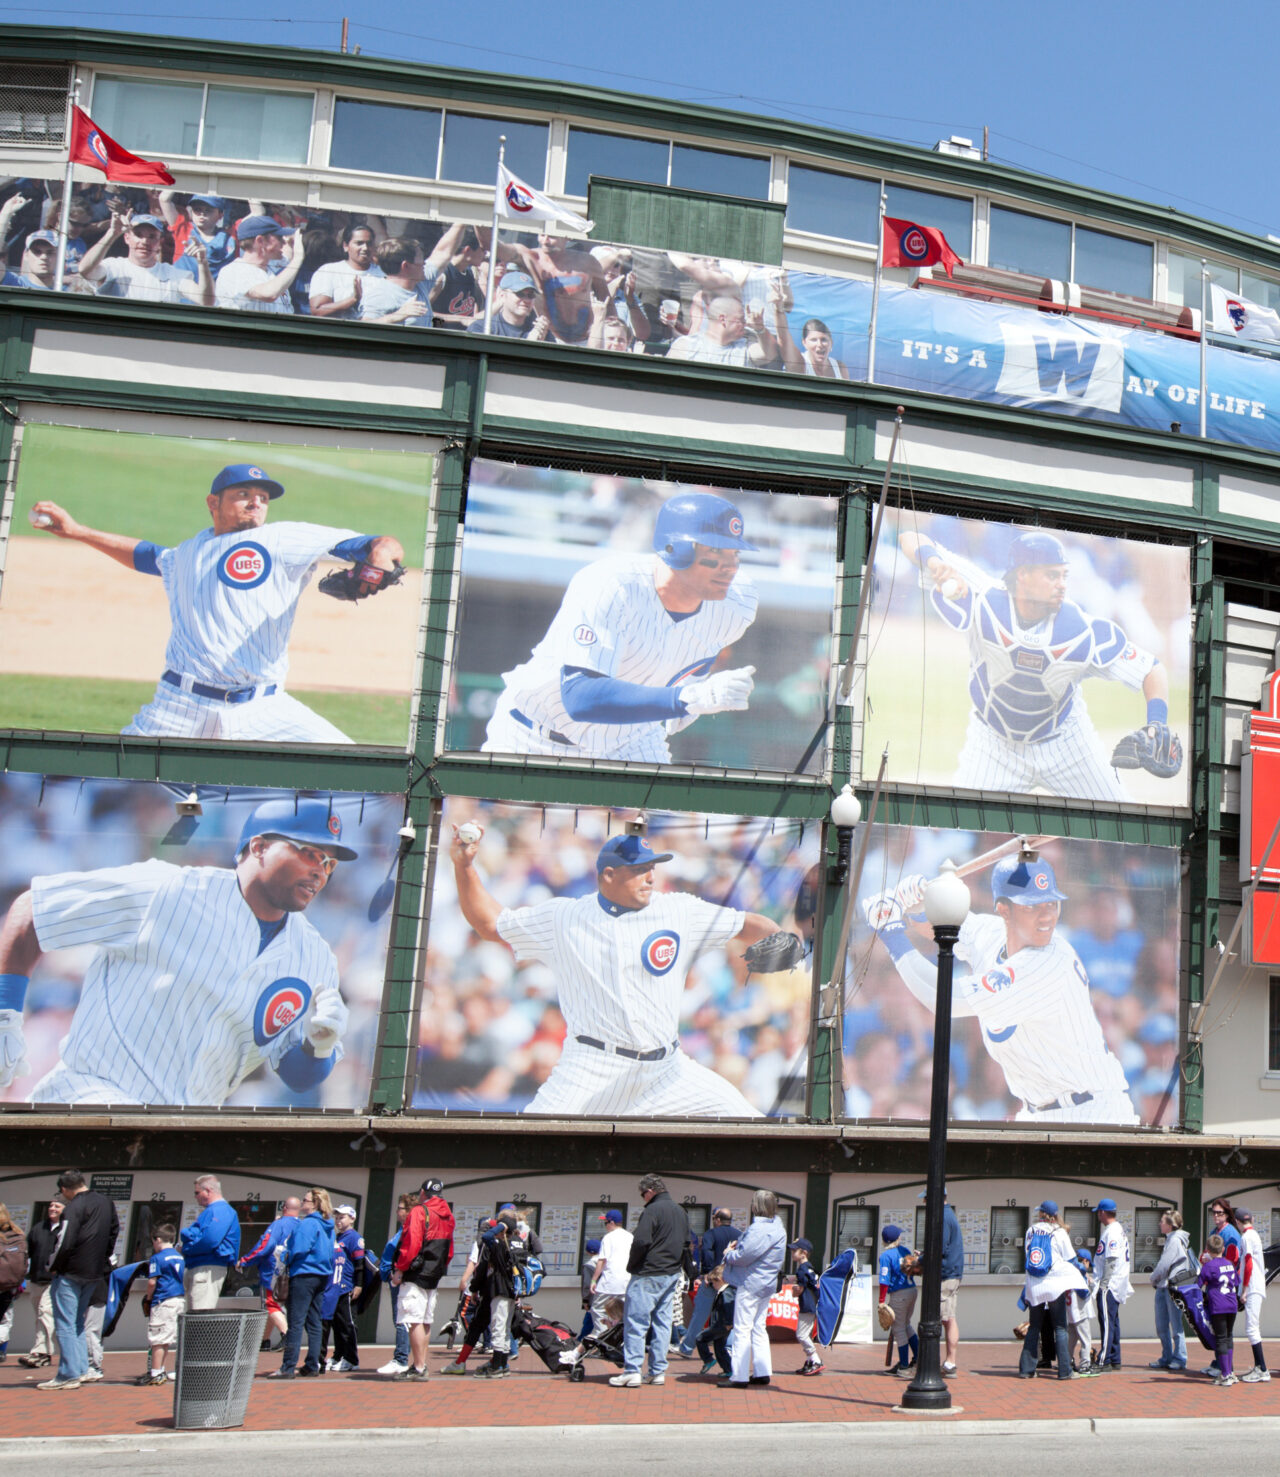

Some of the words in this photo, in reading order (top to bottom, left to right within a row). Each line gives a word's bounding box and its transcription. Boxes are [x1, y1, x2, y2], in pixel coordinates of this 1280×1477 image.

[902, 340, 959, 364] IT'S
[969, 350, 988, 369] A
[1168, 384, 1201, 406] OF
[1210, 392, 1266, 420] LIFE
[226, 549, 262, 581] CUBS
[650, 938, 675, 968] CUBS
[151, 1192, 166, 1202] 25
[246, 1192, 261, 1201] 24
[513, 1193, 527, 1202] 22
[684, 1195, 697, 1204] 20
[855, 1197, 866, 1206] 18
[1006, 1198, 1016, 1207] 16
